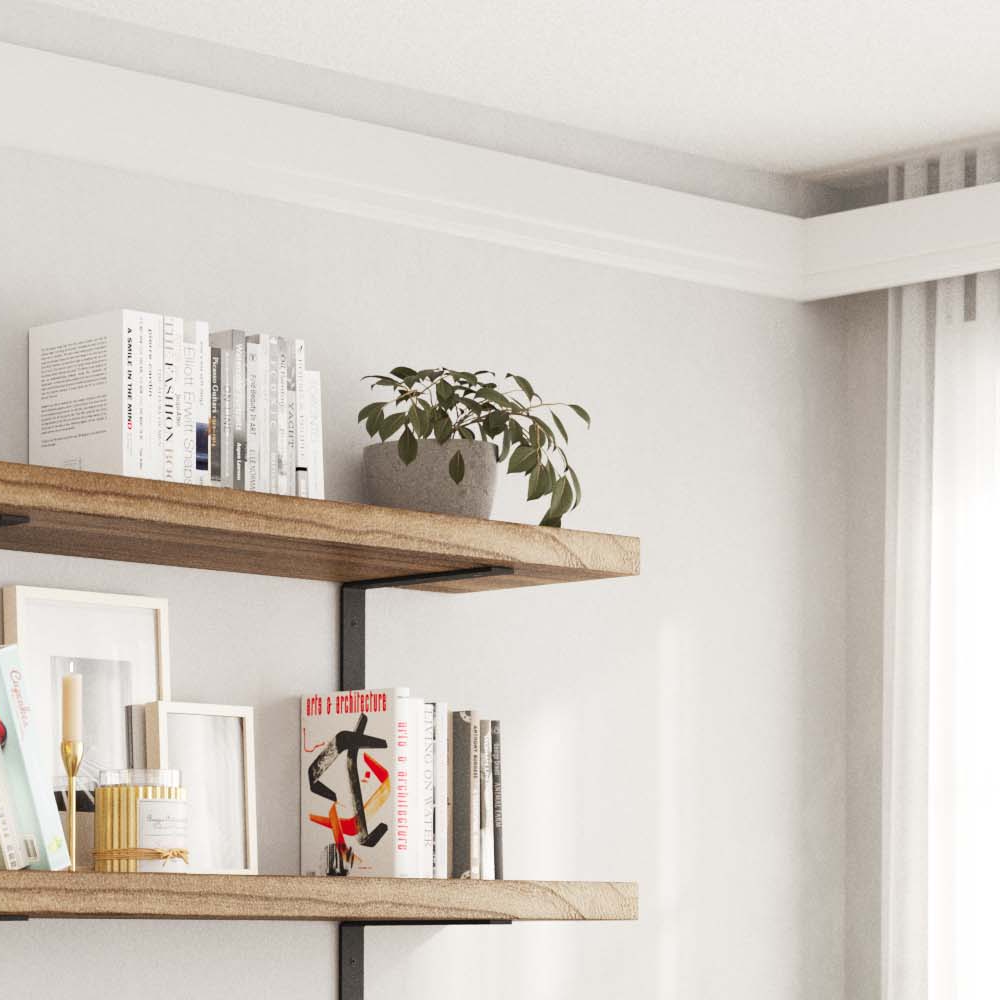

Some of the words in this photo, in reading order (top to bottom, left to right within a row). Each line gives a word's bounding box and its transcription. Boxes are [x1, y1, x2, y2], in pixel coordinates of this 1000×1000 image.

[126, 337, 134, 366] SMILE
[126, 369, 134, 380] IN
[182, 346, 194, 386] Elliott
[126, 382, 134, 401] THE
[126, 403, 134, 430] MIND
[182, 391, 194, 433] Erwitt
[306, 694, 323, 716] arts
[335, 691, 388, 714] architecture
[397, 721, 408, 747] arts
[423, 710, 433, 764] LIVING
[423, 769, 433, 791] ON
[397, 771, 409, 851] architecture
[423, 797, 433, 848] WATER
